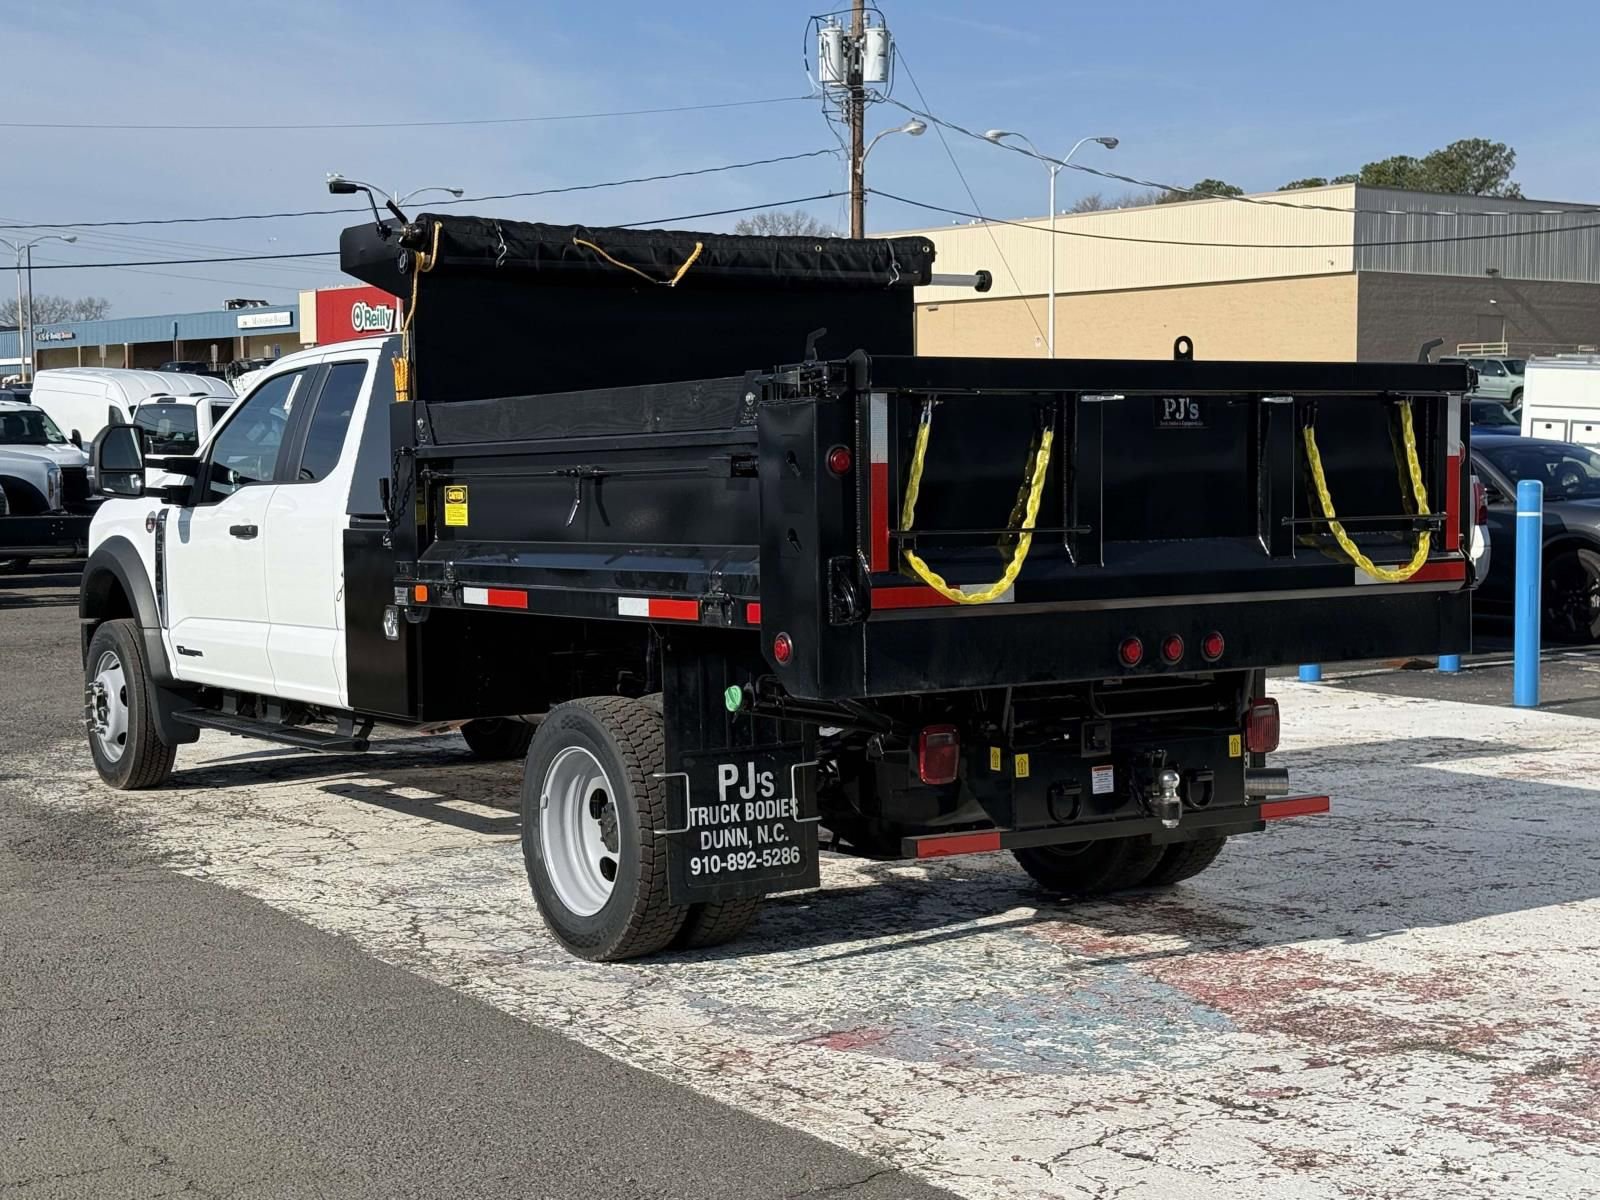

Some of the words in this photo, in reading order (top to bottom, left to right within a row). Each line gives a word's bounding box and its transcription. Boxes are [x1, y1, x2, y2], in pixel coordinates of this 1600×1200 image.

[352, 303, 393, 331] O'Reilly
[1163, 397, 1199, 420] PJ's
[718, 761, 775, 802] PJ's
[690, 803, 741, 827] TRUCK
[745, 798, 799, 820] BODIES
[700, 826, 753, 850] DUNN,
[757, 823, 790, 844] N.C.
[690, 846, 801, 876] 910-892-5286
